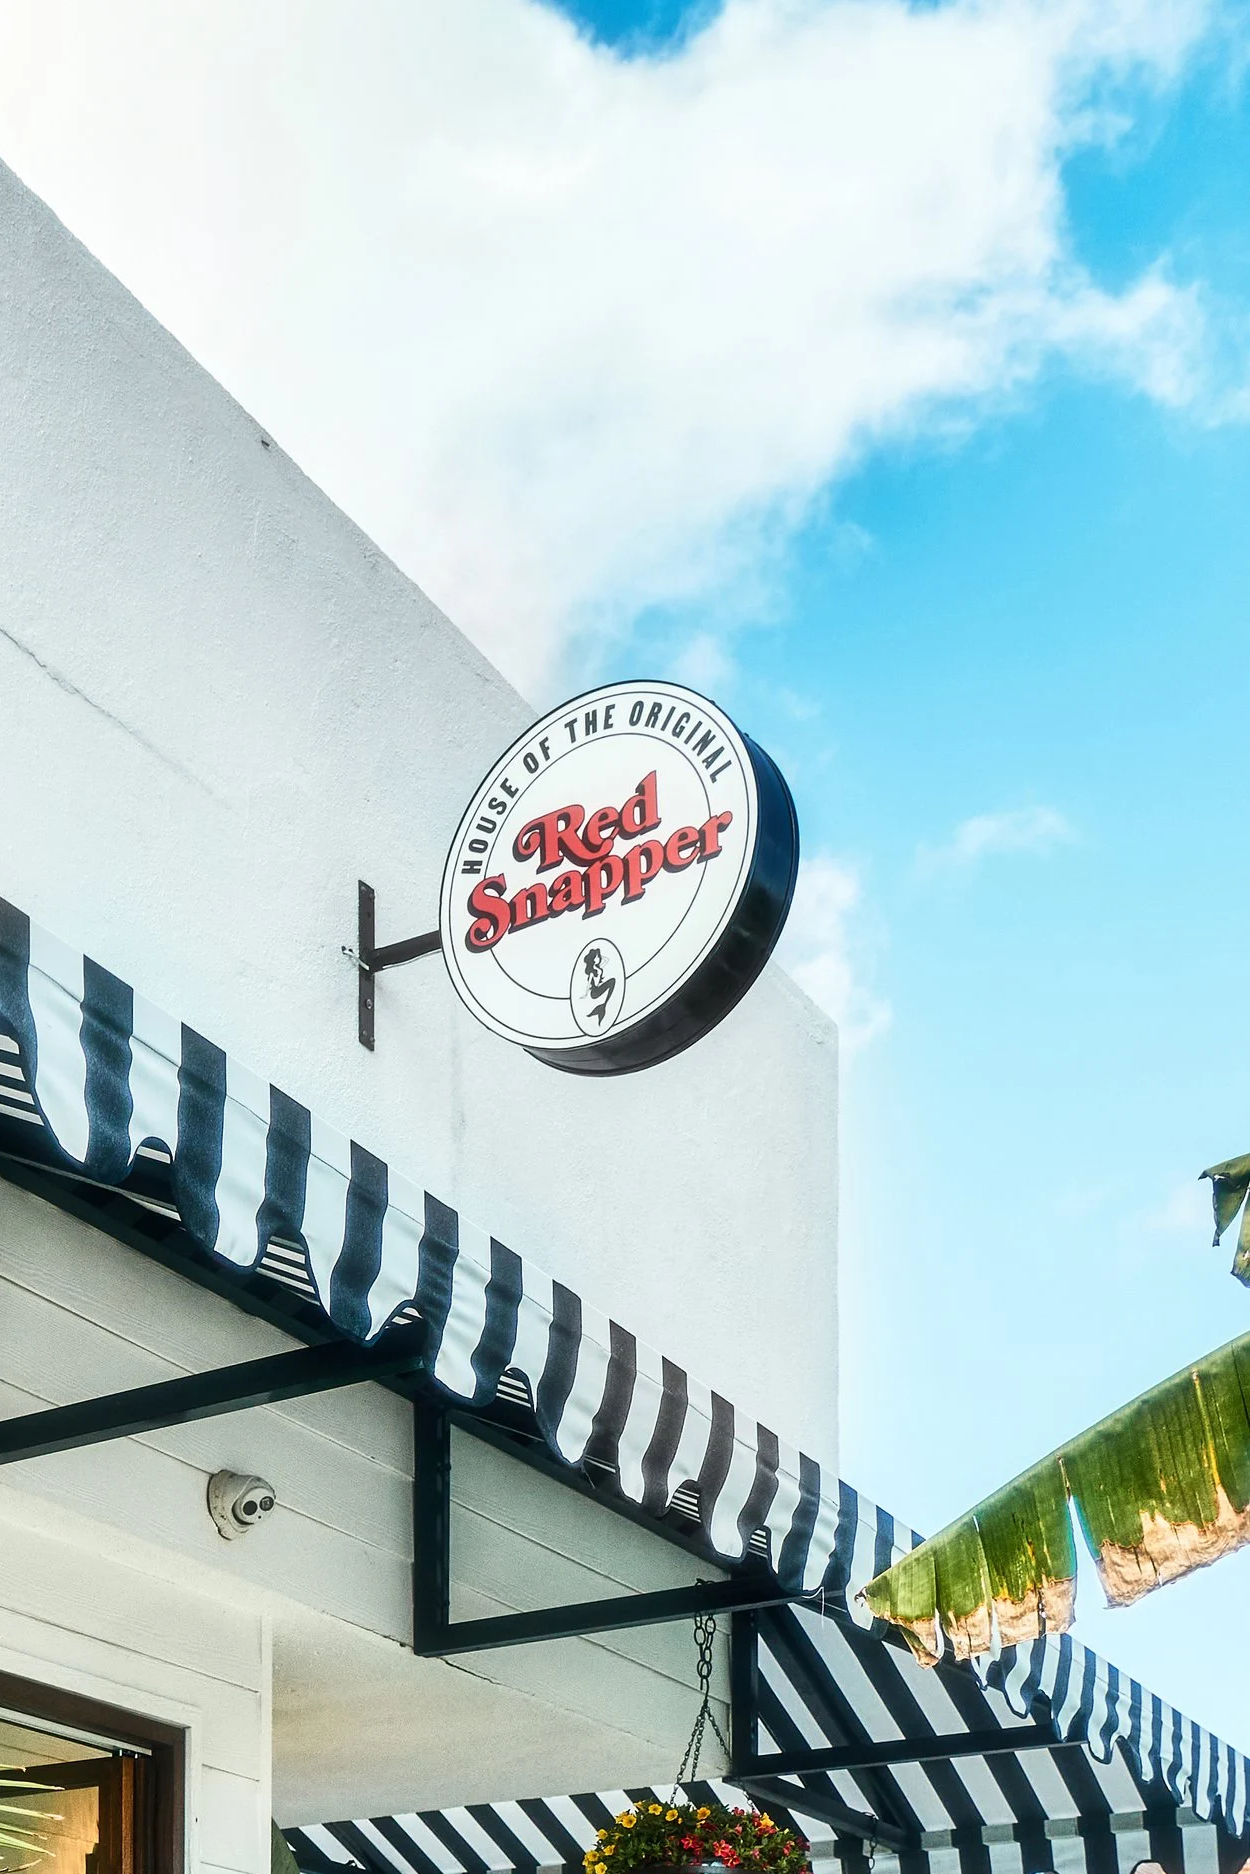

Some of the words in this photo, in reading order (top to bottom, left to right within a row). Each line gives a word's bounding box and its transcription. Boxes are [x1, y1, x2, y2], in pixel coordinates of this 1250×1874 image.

[461, 777, 520, 876] HOUSE
[522, 736, 553, 773] OF
[564, 703, 617, 744] THE
[627, 700, 733, 785] ORIGINAL
[511, 769, 663, 875] Red
[463, 810, 733, 954] Snapper
